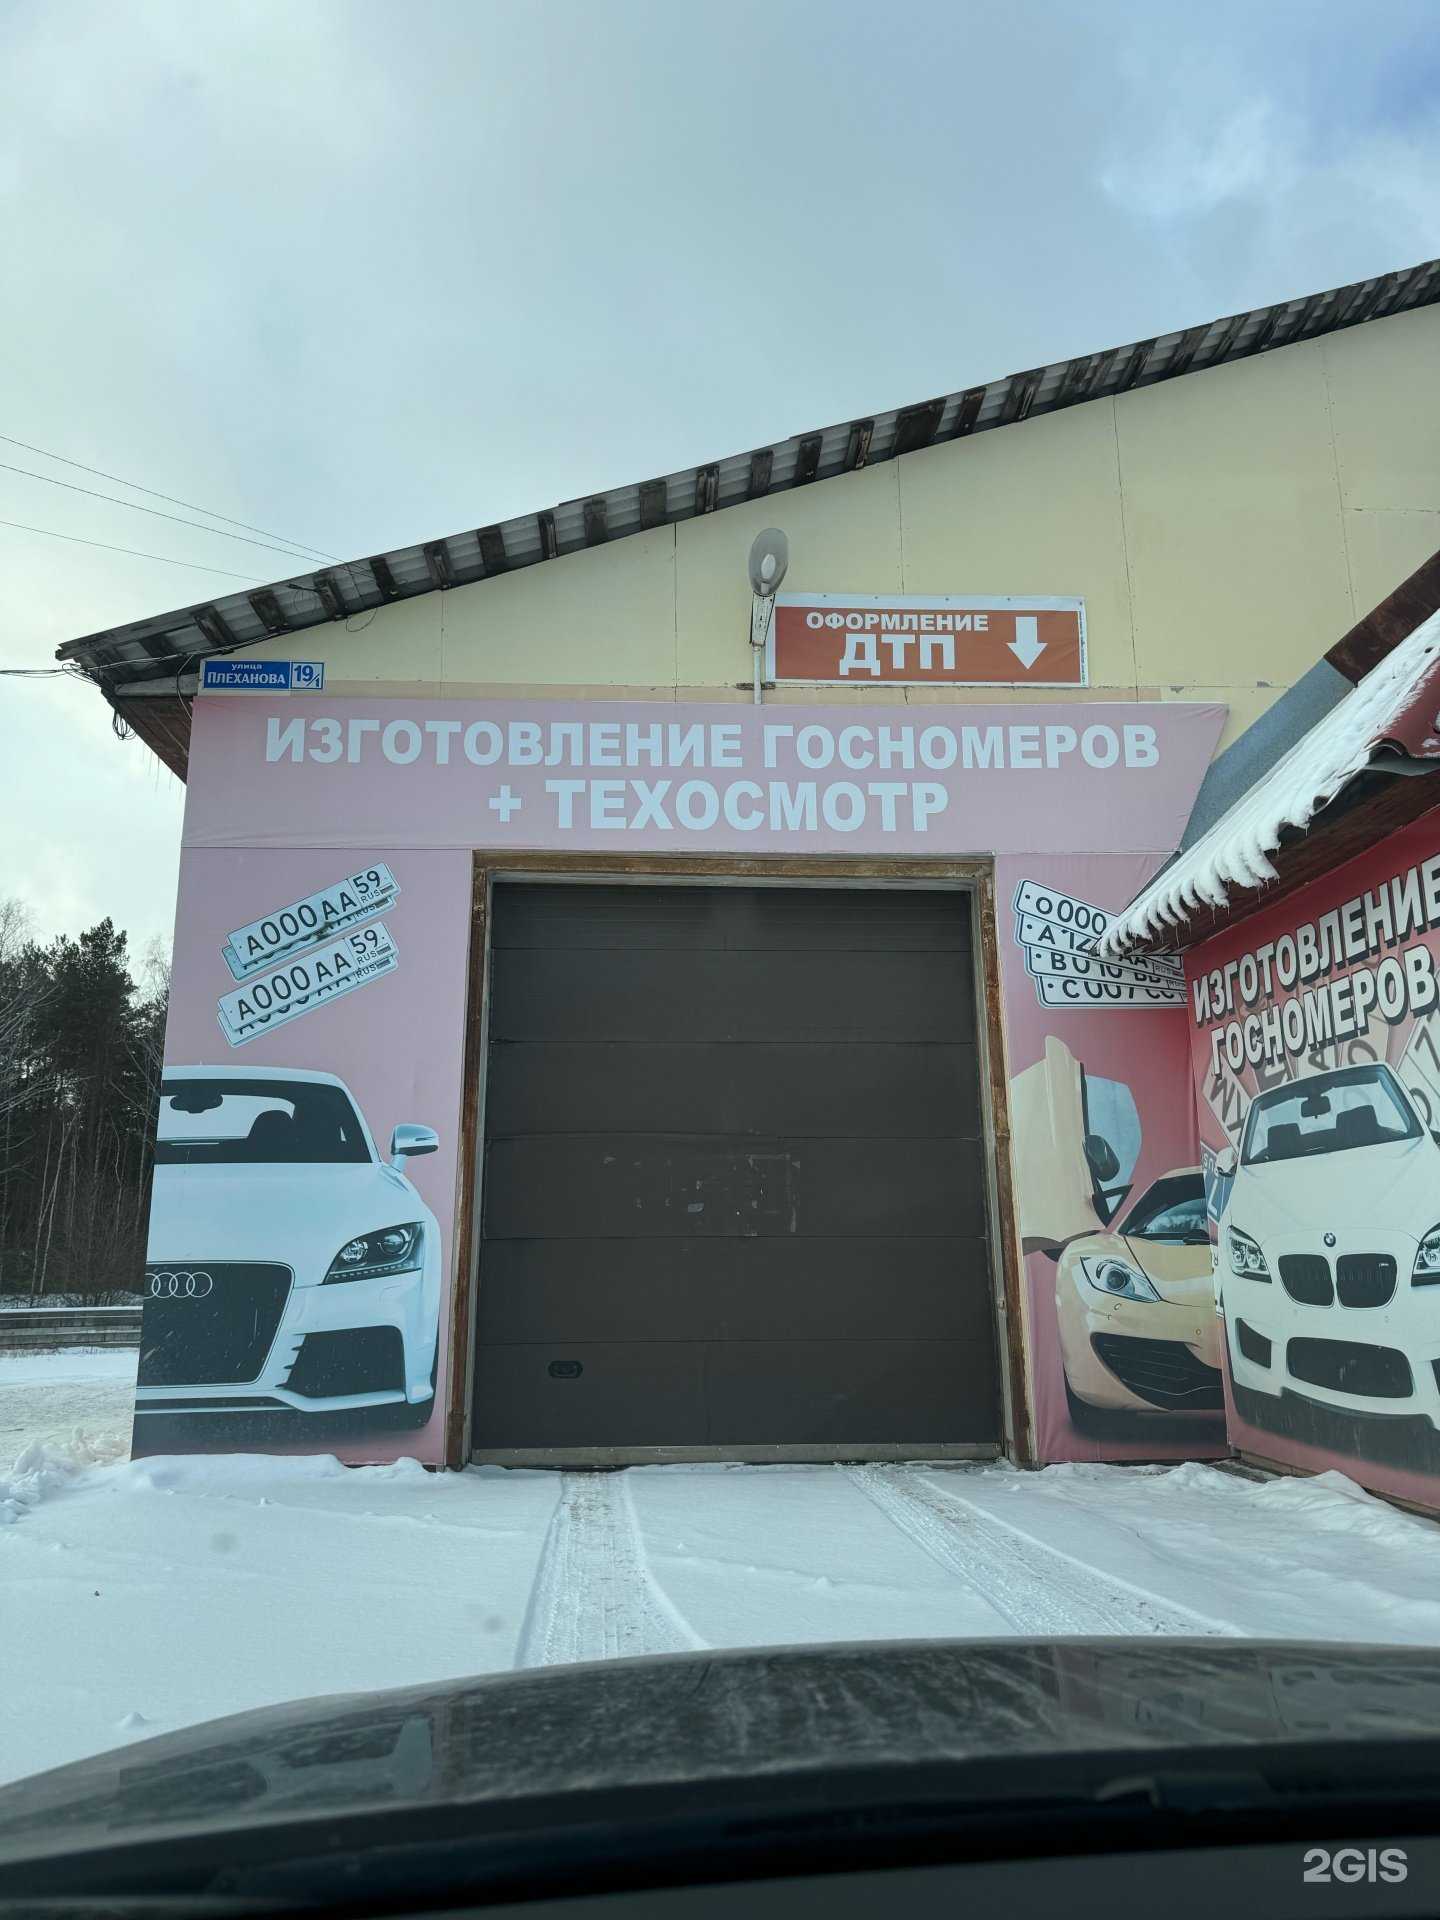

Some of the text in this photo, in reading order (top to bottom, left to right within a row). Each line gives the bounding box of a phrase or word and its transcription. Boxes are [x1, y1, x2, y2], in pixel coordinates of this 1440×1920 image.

[806, 611, 989, 632] ОФОРМЛЕНИЕ
[207, 671, 285, 684] ПЛЕХАНОВА
[231, 663, 262, 671] улица
[839, 634, 956, 676] ДТП
[265, 717, 1160, 770] ИЗГОТОВЛЕНИЕ ГОСНОМЕРОВ
[545, 779, 949, 832] ТЕХОСМОТР
[1192, 855, 1440, 1025] ИЗГОТОВЛЕНИЕ
[1211, 945, 1438, 1078] ГОСНОМЕРОВ
